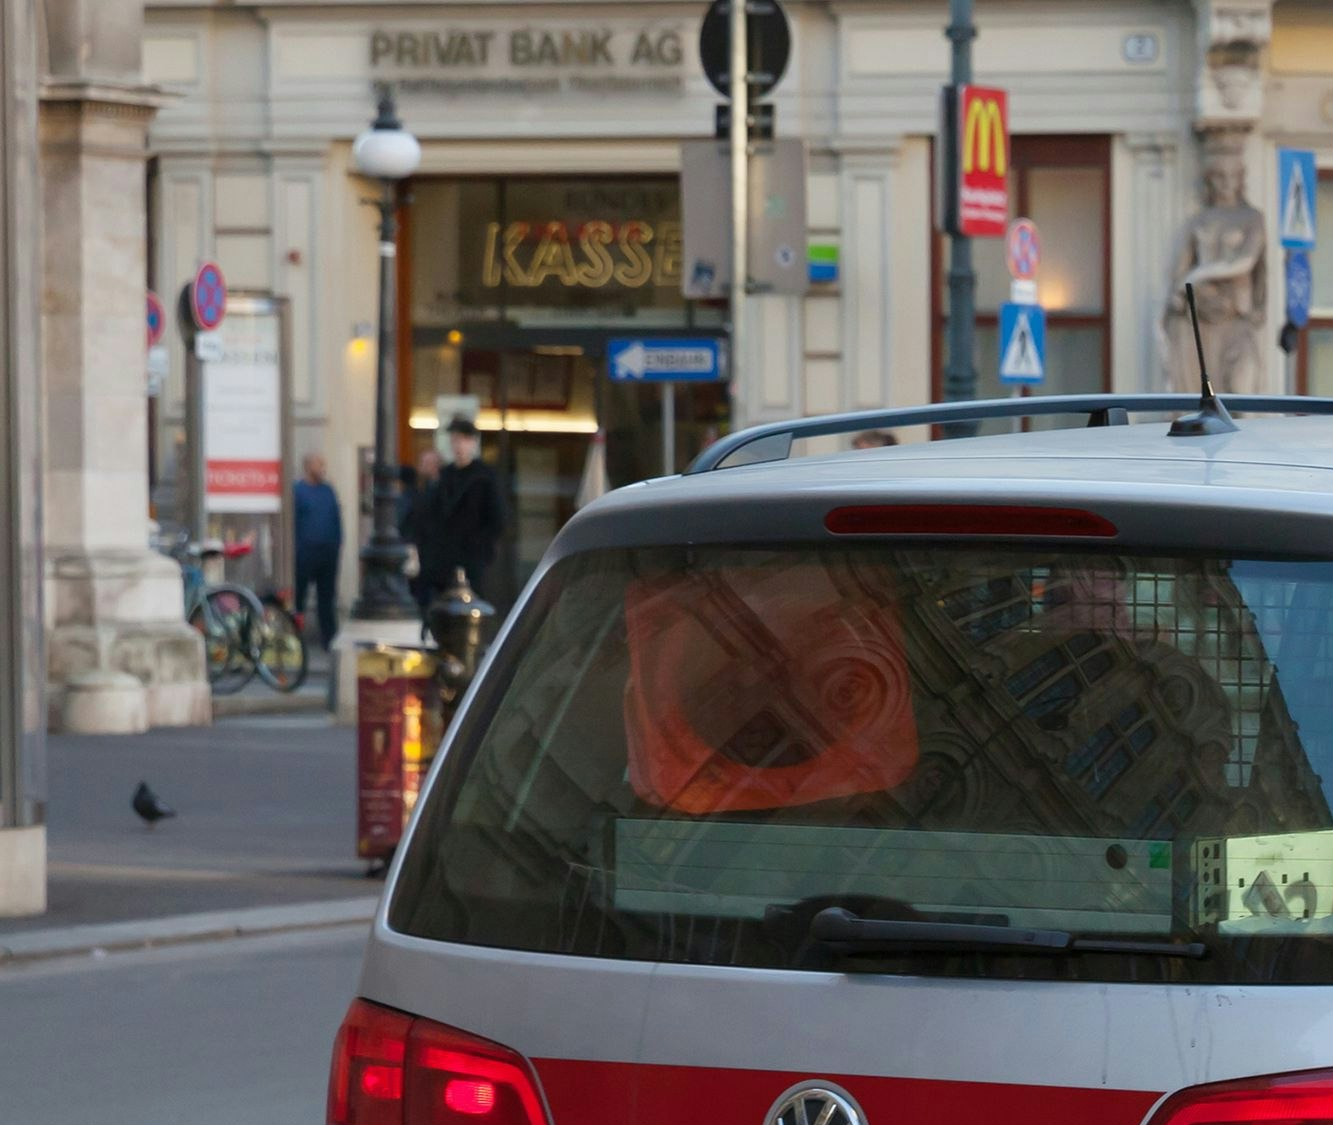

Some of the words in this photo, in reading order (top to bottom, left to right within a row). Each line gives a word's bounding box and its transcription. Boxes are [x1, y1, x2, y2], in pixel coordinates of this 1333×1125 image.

[370, 29, 496, 66] PRIVAT
[509, 30, 614, 66] BANK
[631, 31, 684, 66] AG
[482, 219, 682, 289] KASSE
